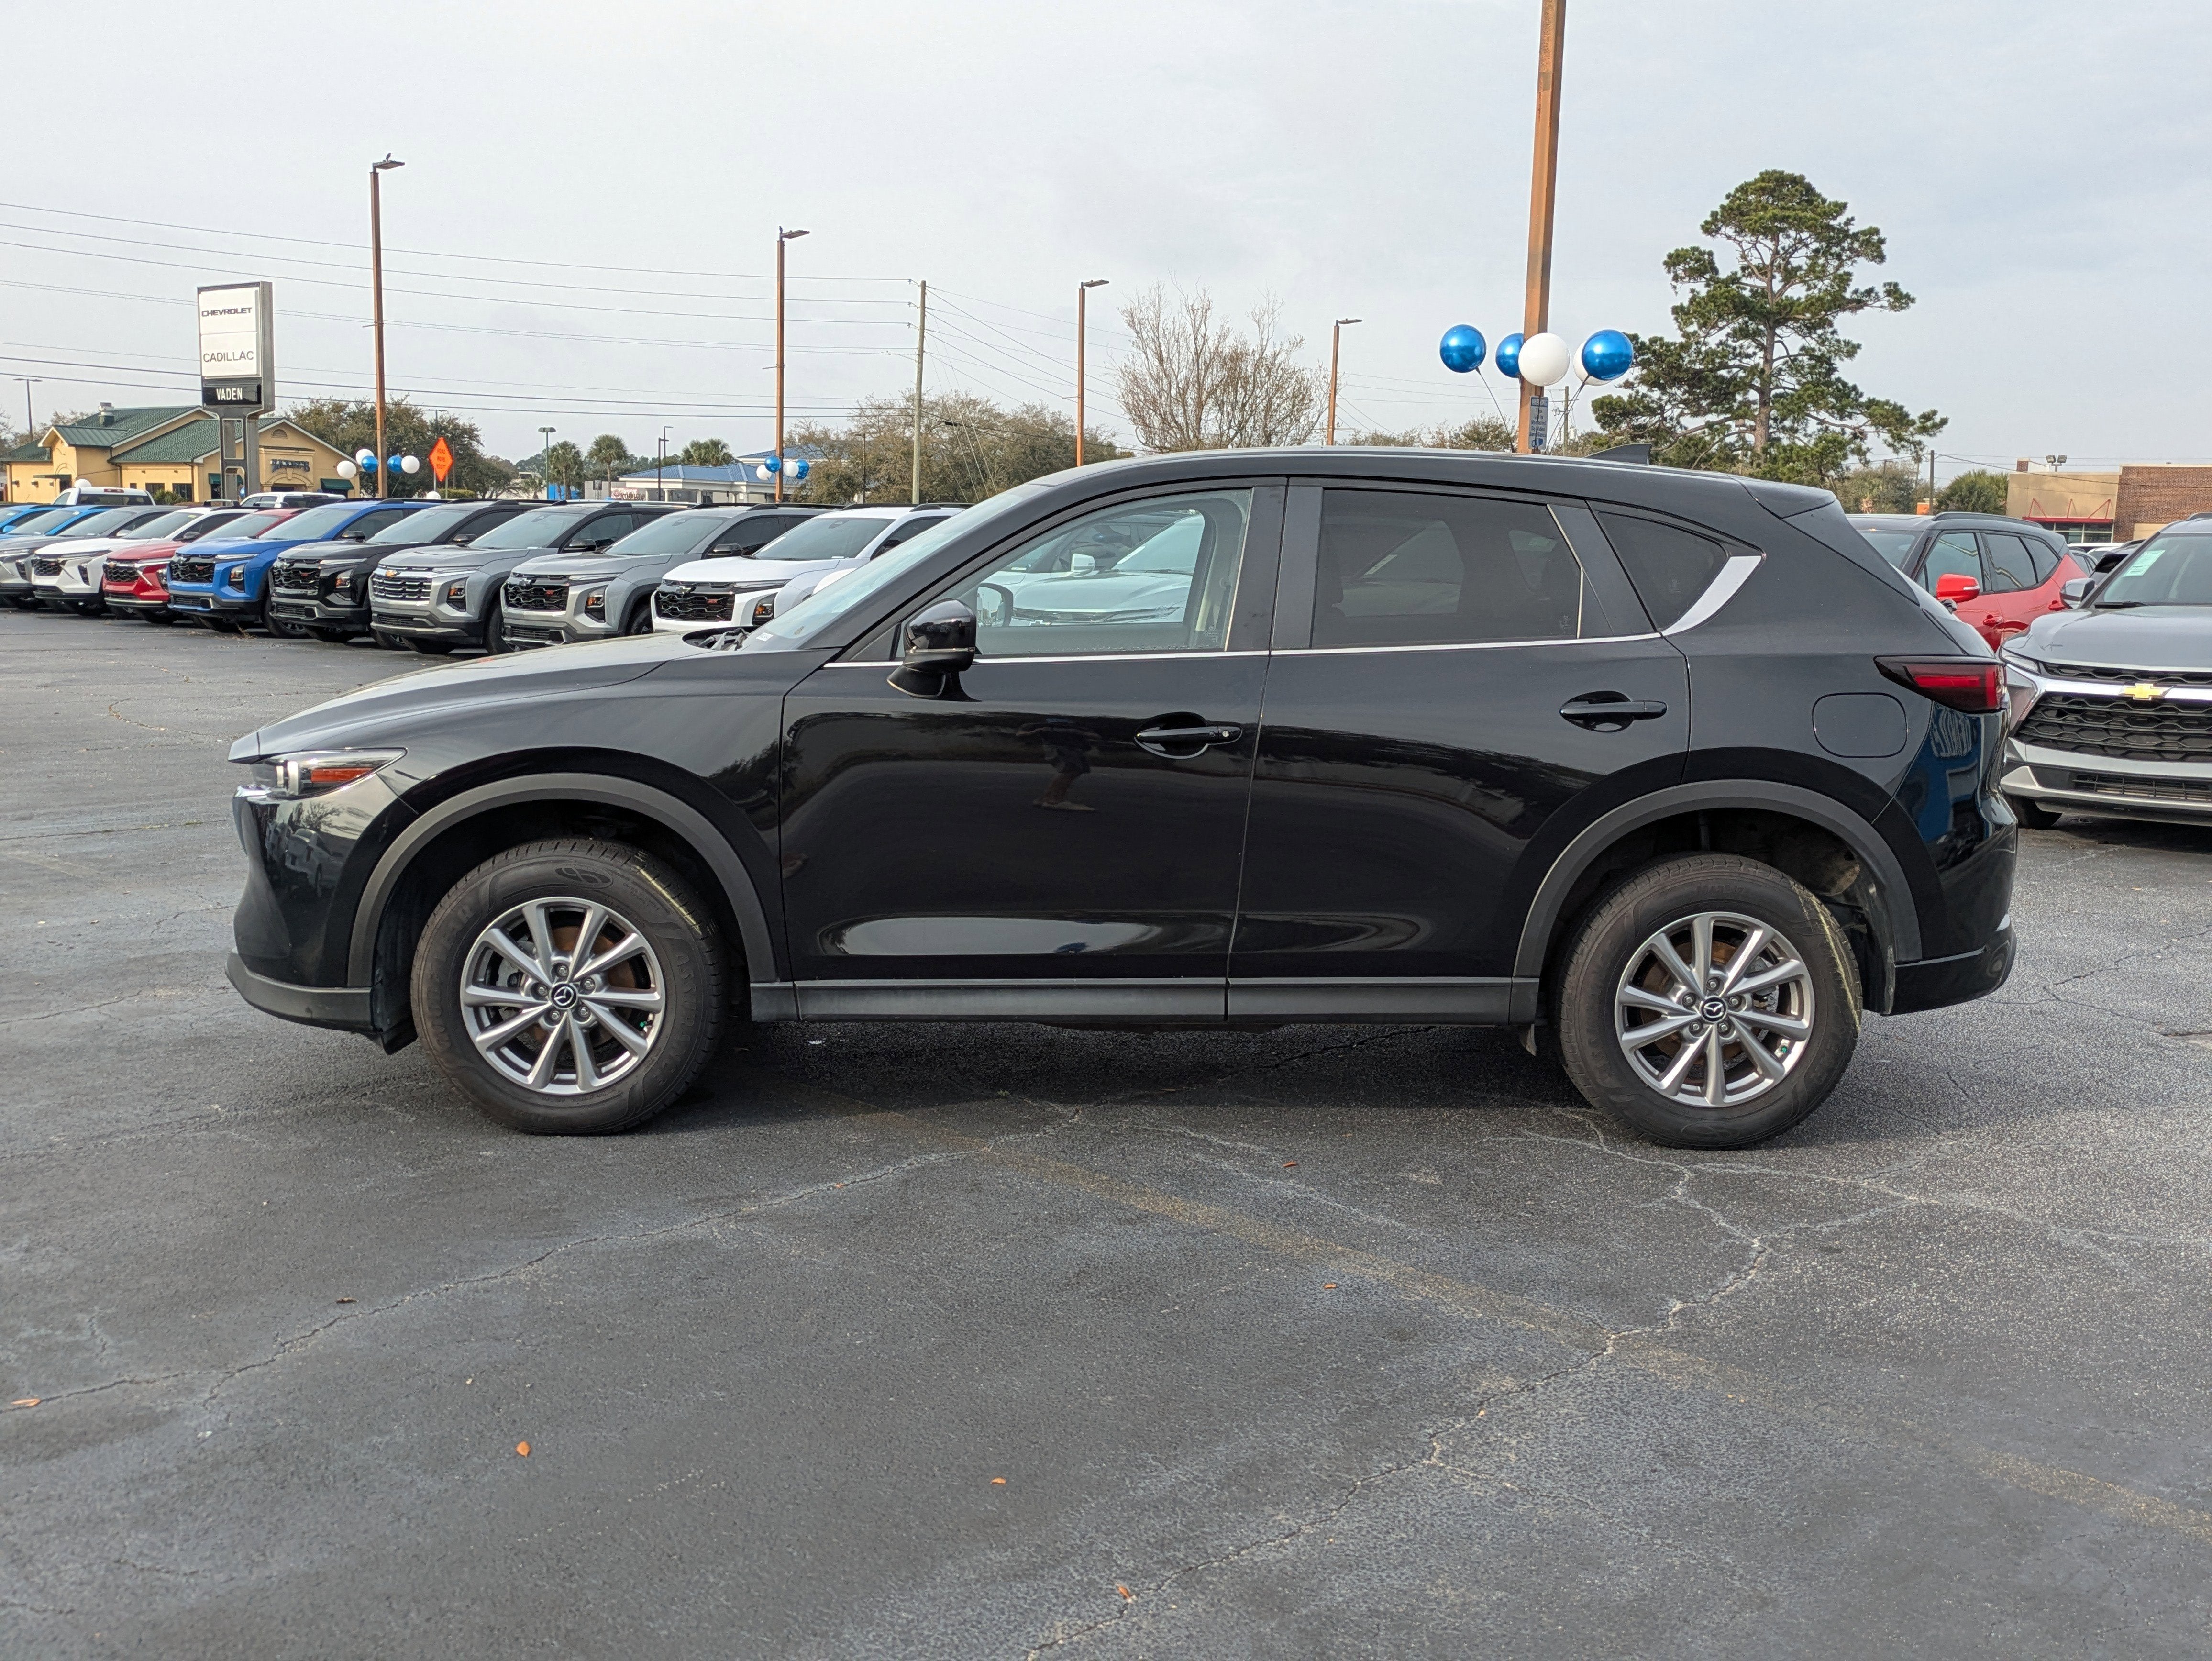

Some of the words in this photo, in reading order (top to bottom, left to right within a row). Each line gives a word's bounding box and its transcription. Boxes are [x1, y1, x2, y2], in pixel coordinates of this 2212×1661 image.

[201, 307, 253, 317] CHEVROLET
[203, 351, 254, 363] CADILLAC
[216, 388, 243, 400] VADEN
